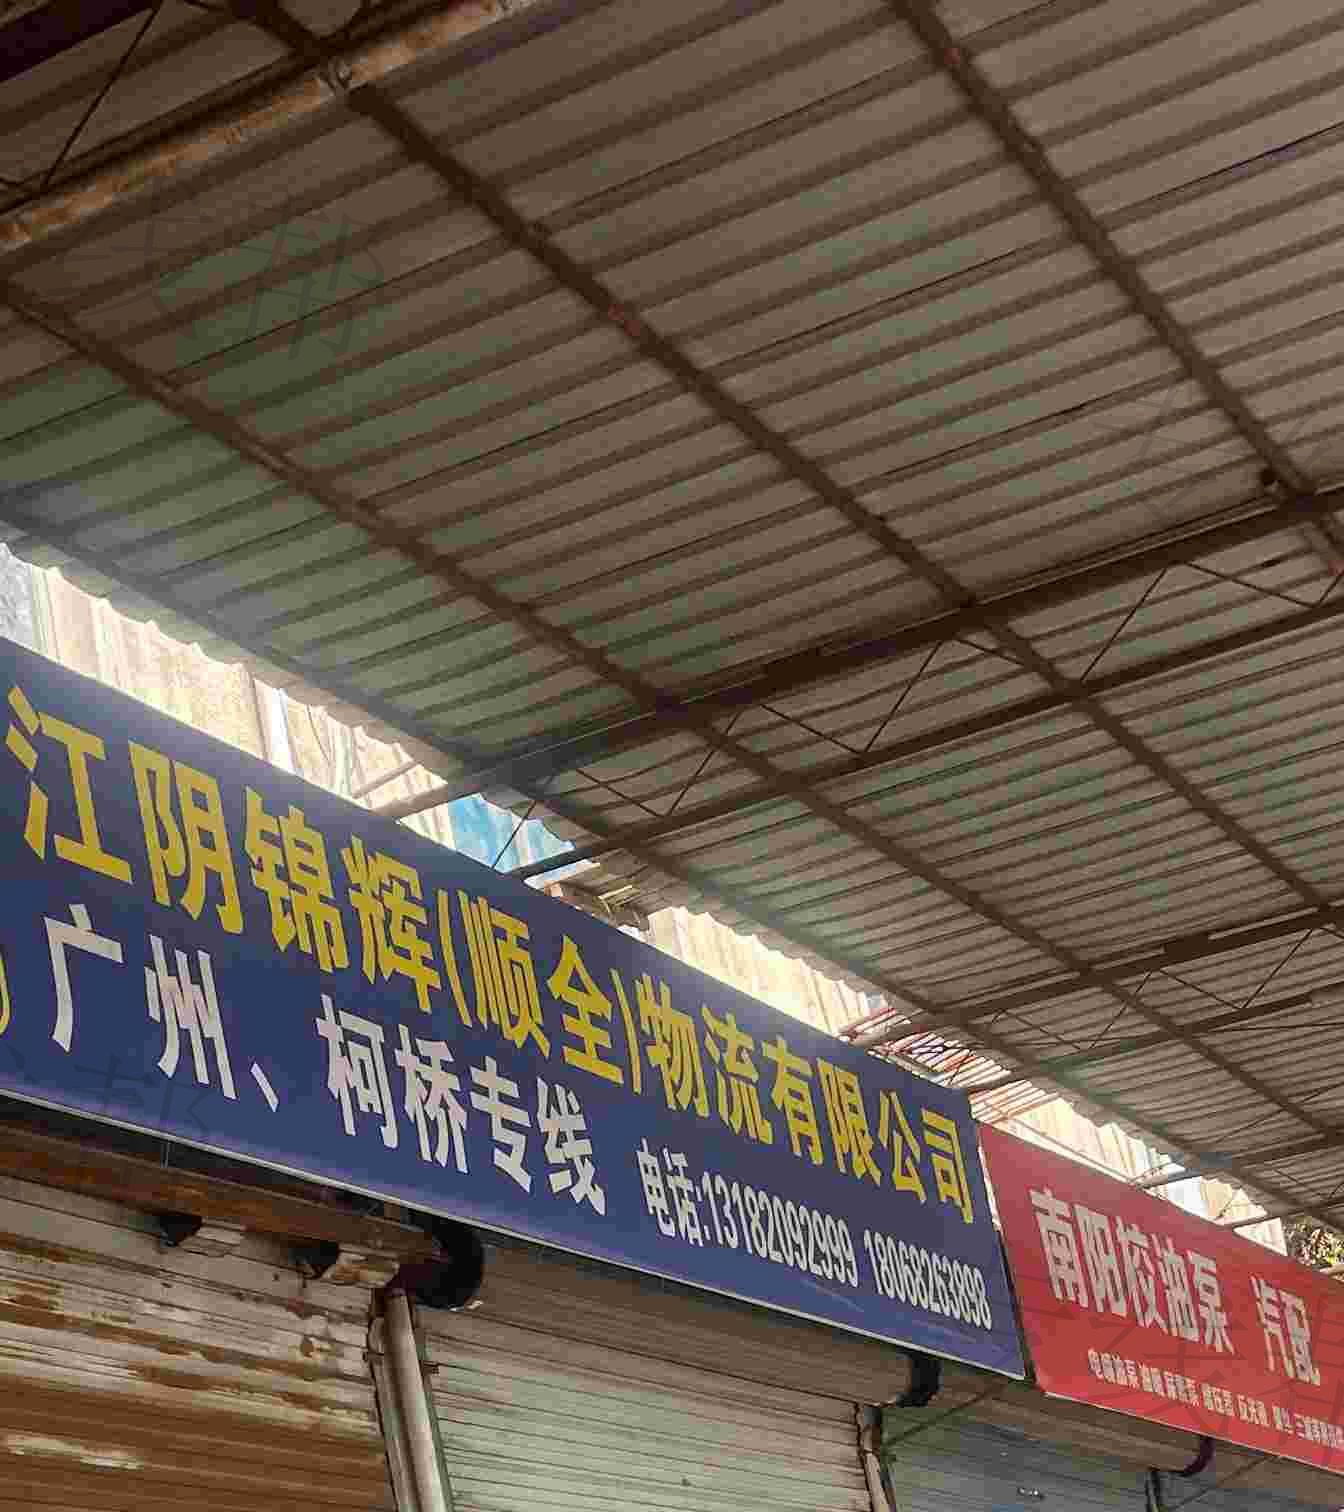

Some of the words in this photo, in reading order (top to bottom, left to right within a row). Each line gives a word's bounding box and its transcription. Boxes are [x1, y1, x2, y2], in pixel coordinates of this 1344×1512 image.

[1029, 1185, 1236, 1357] 南阳校油泵
[1249, 1271, 1322, 1387] 汽配
